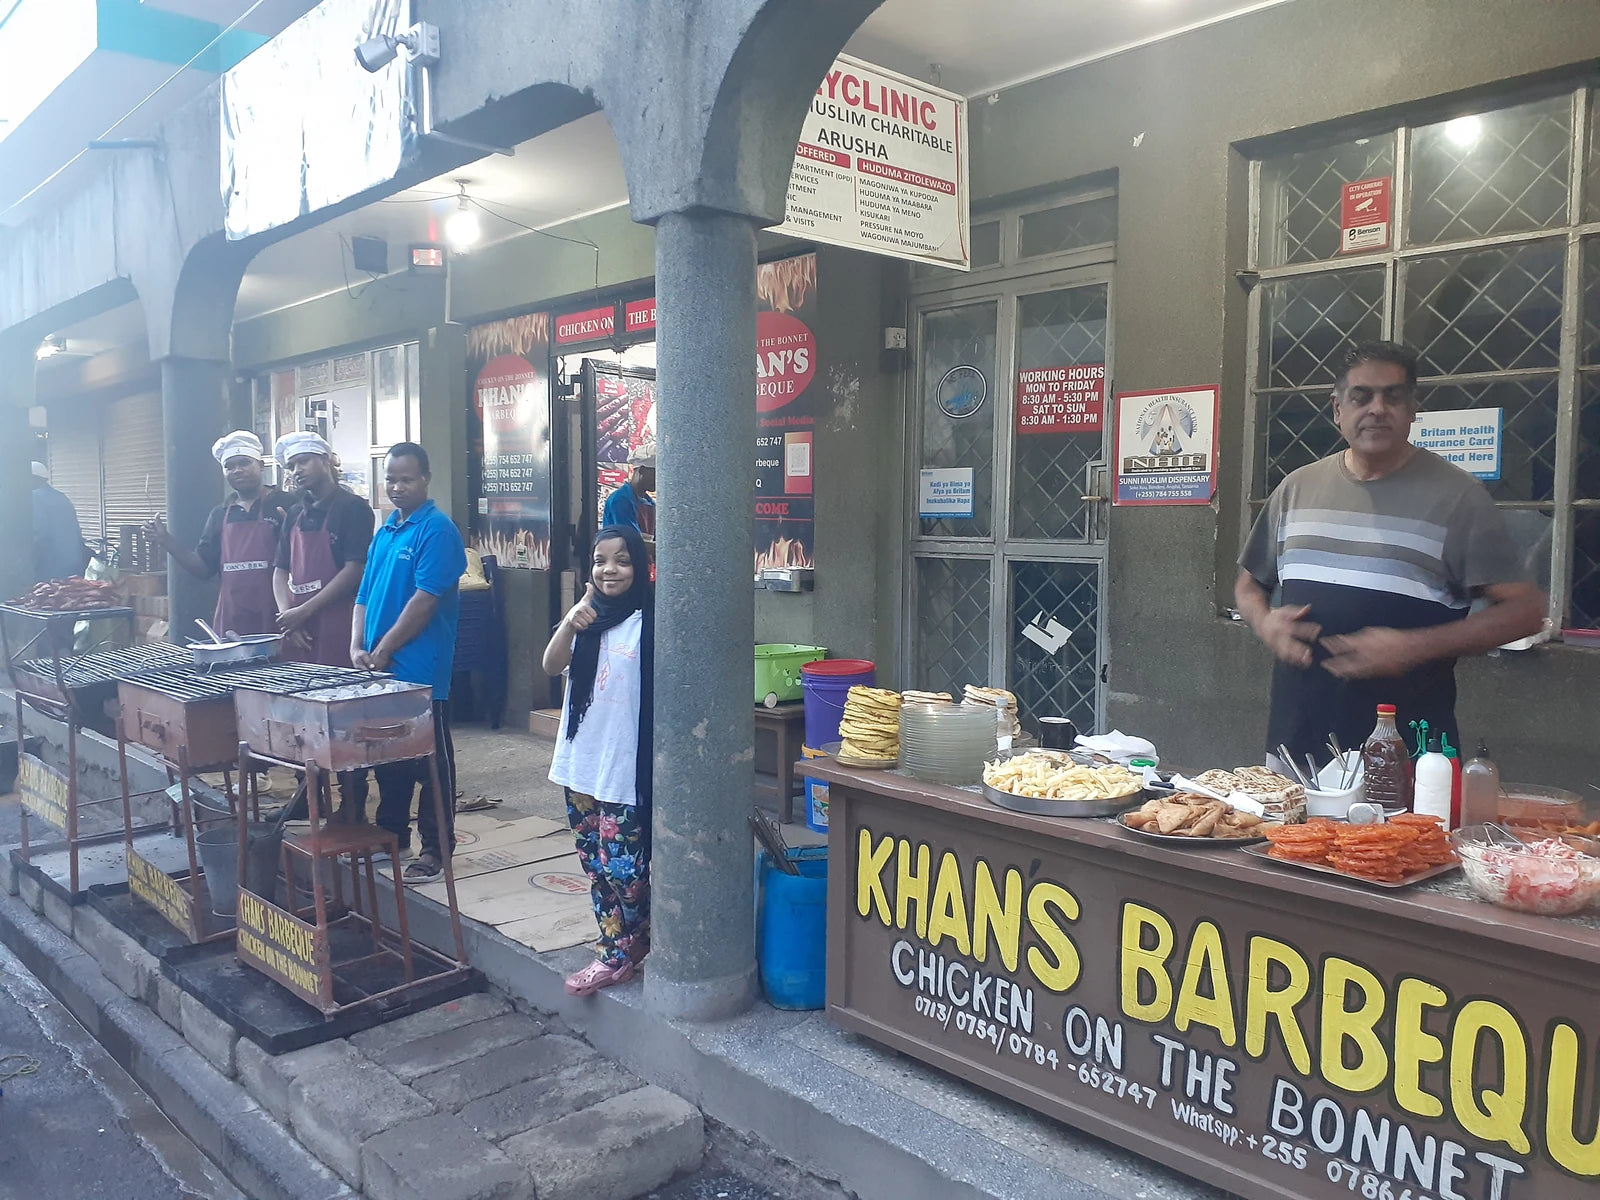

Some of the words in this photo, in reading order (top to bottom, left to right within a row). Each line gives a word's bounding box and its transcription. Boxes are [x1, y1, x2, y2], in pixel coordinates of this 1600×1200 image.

[816, 70, 937, 131] YCLINIC
[871, 118, 953, 153] CHARITABLE
[818, 128, 888, 160] ARUSHA
[796, 144, 836, 162] OFFERED
[862, 161, 902, 179] HUDUMA
[904, 172, 952, 192] ZITOLEWAZO
[859, 178, 899, 193] MAGONJWA
[859, 188, 890, 201] HUDUMA
[790, 204, 842, 222] MANAGEMENT
[859, 200, 891, 212] HUDUMA
[892, 206, 900, 214] YA
[901, 208, 921, 219] MENO
[860, 210, 890, 222] KISUKARI
[793, 216, 815, 227] VISITS
[860, 220, 892, 233] PRESSURE
[904, 229, 924, 240] MOYO
[860, 230, 900, 245] WAGONJWA
[628, 310, 648, 325] THE
[559, 319, 599, 337] CHICKEN
[600, 316, 615, 330] ON
[761, 337, 775, 347] THE
[777, 333, 809, 345] BONNET
[1019, 369, 1066, 383] WORKING
[1068, 366, 1105, 380] HOURS
[1025, 383, 1046, 393] MON
[1048, 382, 1060, 391] TO
[1062, 380, 1095, 391] FRIDAY
[1022, 395, 1040, 405] 8:30
[1042, 394, 1056, 404] AM
[1063, 392, 1082, 403] 5:30
[1085, 391, 1099, 401] PM
[1033, 405, 1049, 414] SAT
[1052, 404, 1064, 413] TO
[1066, 403, 1086, 413] SUN
[1021, 416, 1039, 425] 8:30
[1041, 415, 1055, 425] AM
[1062, 414, 1081, 424] 1:30
[1083, 413, 1098, 423] PM
[1420, 427, 1456, 437] Britam
[1459, 425, 1495, 435] Health
[756, 437, 769, 447] 652
[769, 436, 783, 446] 747
[1413, 438, 1465, 448] Insurance
[1469, 436, 1494, 446] Card
[510, 454, 521, 464] 652
[521, 454, 533, 464] 747
[755, 458, 780, 469] rbeque
[1130, 456, 1202, 469] NHIF
[1469, 452, 1494, 461] Here
[481, 469, 499, 481] (+255)
[510, 468, 521, 478] 652
[521, 468, 533, 478] 747
[1140, 476, 1168, 484] MUSLIM
[1168, 475, 1210, 484] DISPENSARY
[481, 482, 499, 494] (+255)
[499, 482, 510, 492] 713
[510, 482, 521, 492] 652
[522, 482, 533, 492] 747
[755, 503, 789, 515] COME
[267, 908, 316, 966] BARBEQUE
[1121, 902, 1600, 1177] BARBEQU
[891, 940, 1034, 1033] CHICKEN
[1065, 1006, 1124, 1070] ON
[1153, 1034, 1237, 1114] THE
[1271, 1078, 1525, 1200] BONNET
